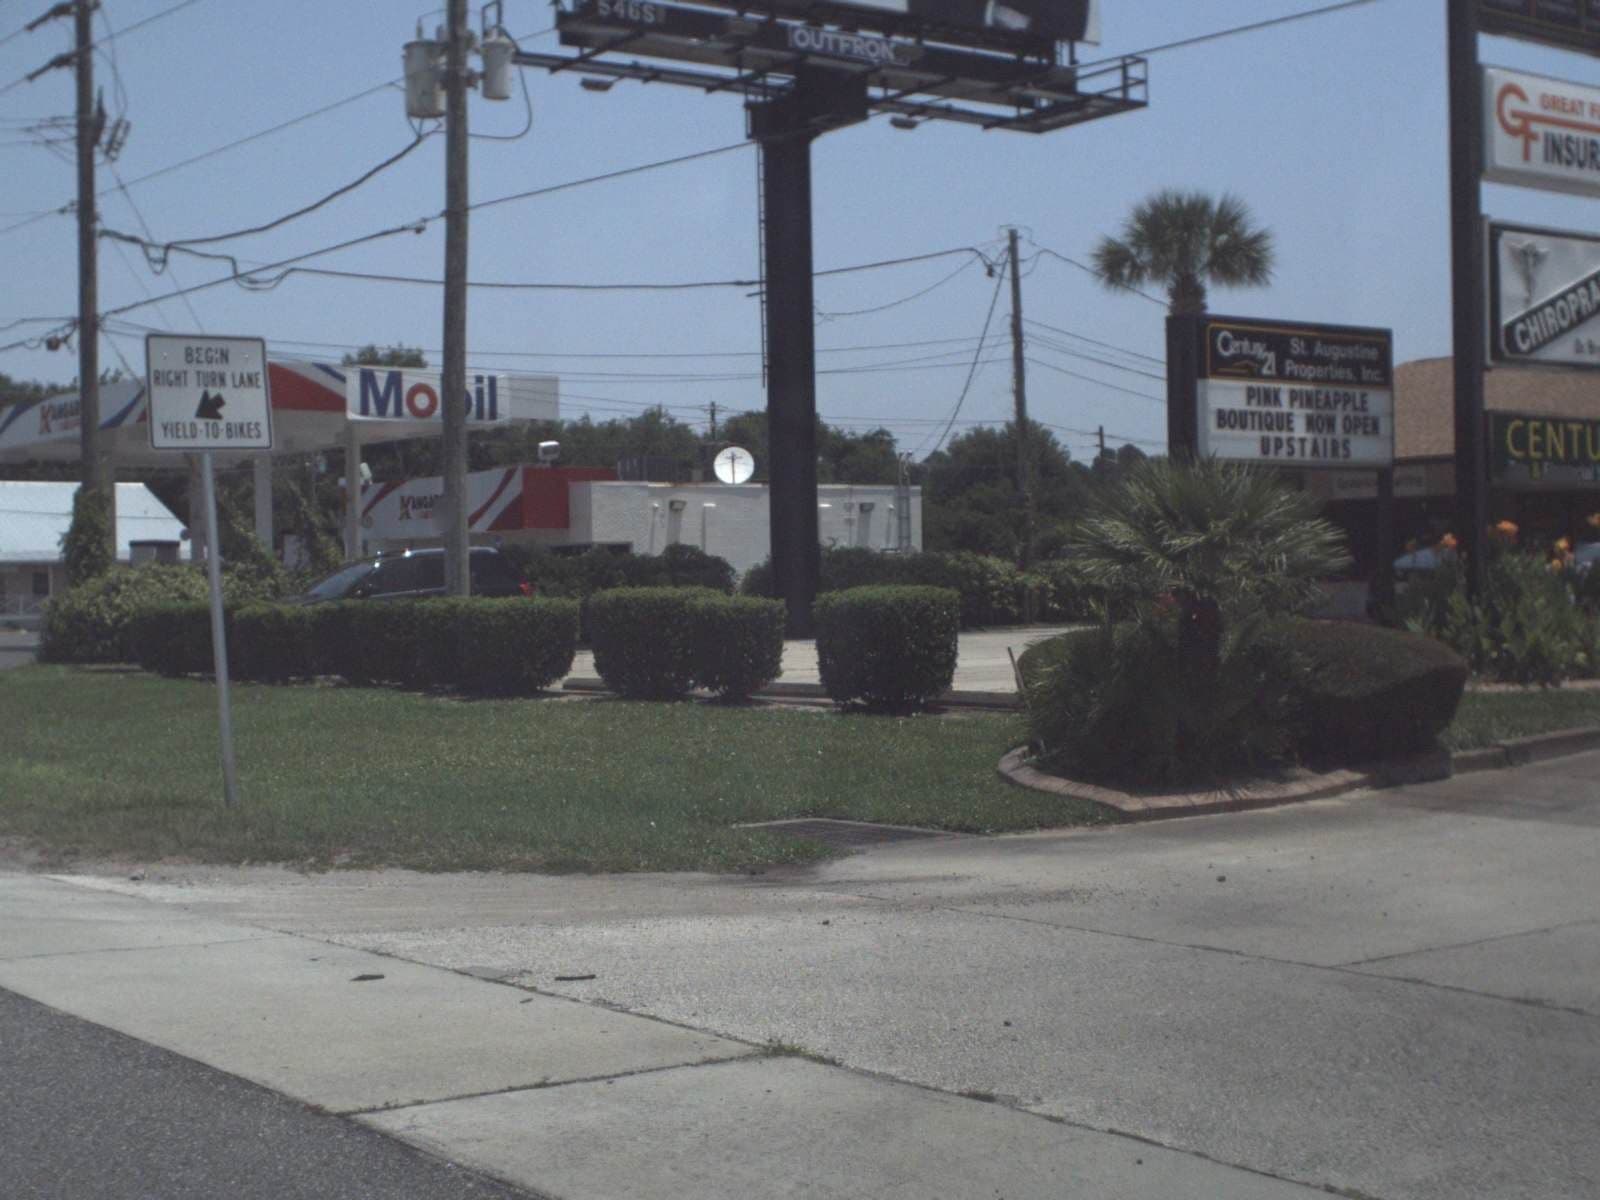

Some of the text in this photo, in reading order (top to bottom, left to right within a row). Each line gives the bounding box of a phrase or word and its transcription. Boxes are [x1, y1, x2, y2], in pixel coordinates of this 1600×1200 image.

[1541, 93, 1585, 117] GREAT
[184, 346, 230, 365] BEGIN
[1261, 351, 1277, 375] 21
[1314, 341, 1379, 361] Augustine
[153, 369, 262, 389] RIGHT TURN LANE
[360, 368, 497, 420] Moil
[1246, 386, 1368, 412] PINK PINEAPPLE
[1216, 409, 1380, 435] BOUTIQUE NOW OPEN
[1261, 436, 1351, 458] UPSTAIRS
